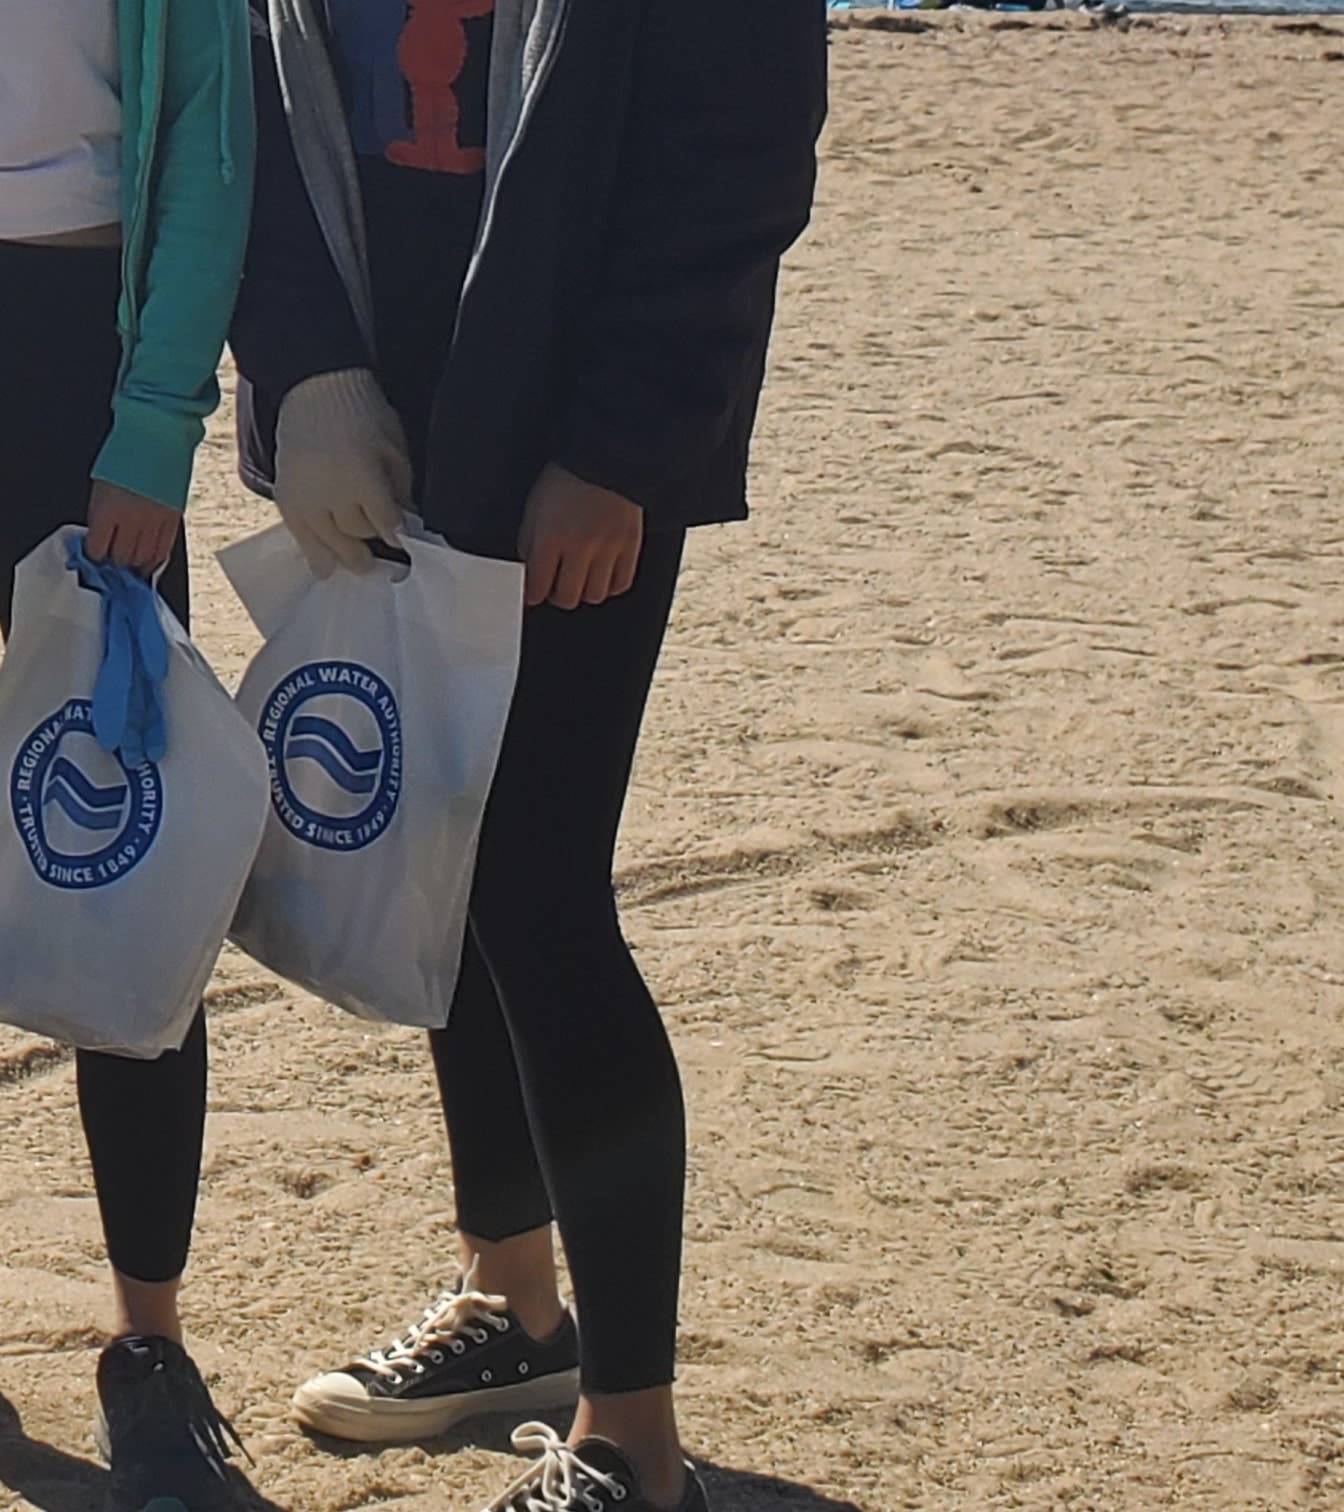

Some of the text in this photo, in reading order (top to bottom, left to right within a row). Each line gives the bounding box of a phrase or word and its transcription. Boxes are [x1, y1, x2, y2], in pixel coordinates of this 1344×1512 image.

[17, 718, 64, 790] REGIONA
[263, 667, 400, 804] REGIONAL WATER AUTHORITY
[18, 803, 137, 883] TRUSTED SINCE 1849
[305, 822, 353, 844] SINCE
[357, 810, 385, 842] 1849
